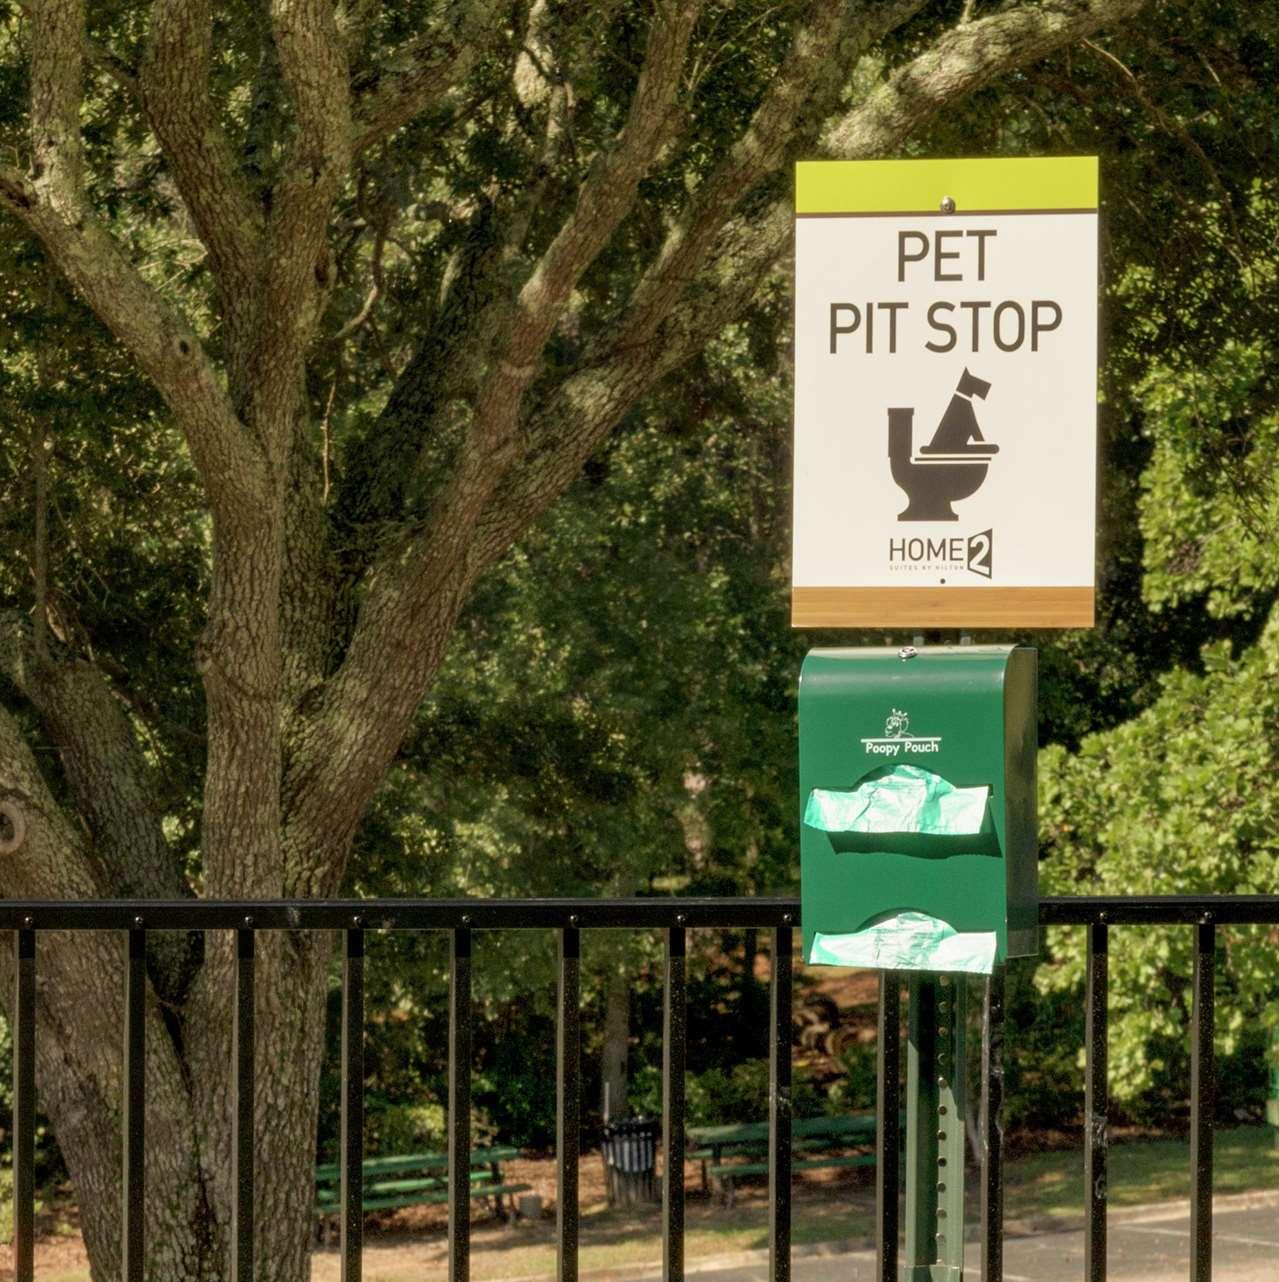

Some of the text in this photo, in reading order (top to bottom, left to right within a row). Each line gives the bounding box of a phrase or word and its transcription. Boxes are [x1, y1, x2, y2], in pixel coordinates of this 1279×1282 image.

[898, 229, 998, 282] PET
[829, 300, 1063, 354] PIT STOP
[865, 740, 939, 756] Poopy Pouch
